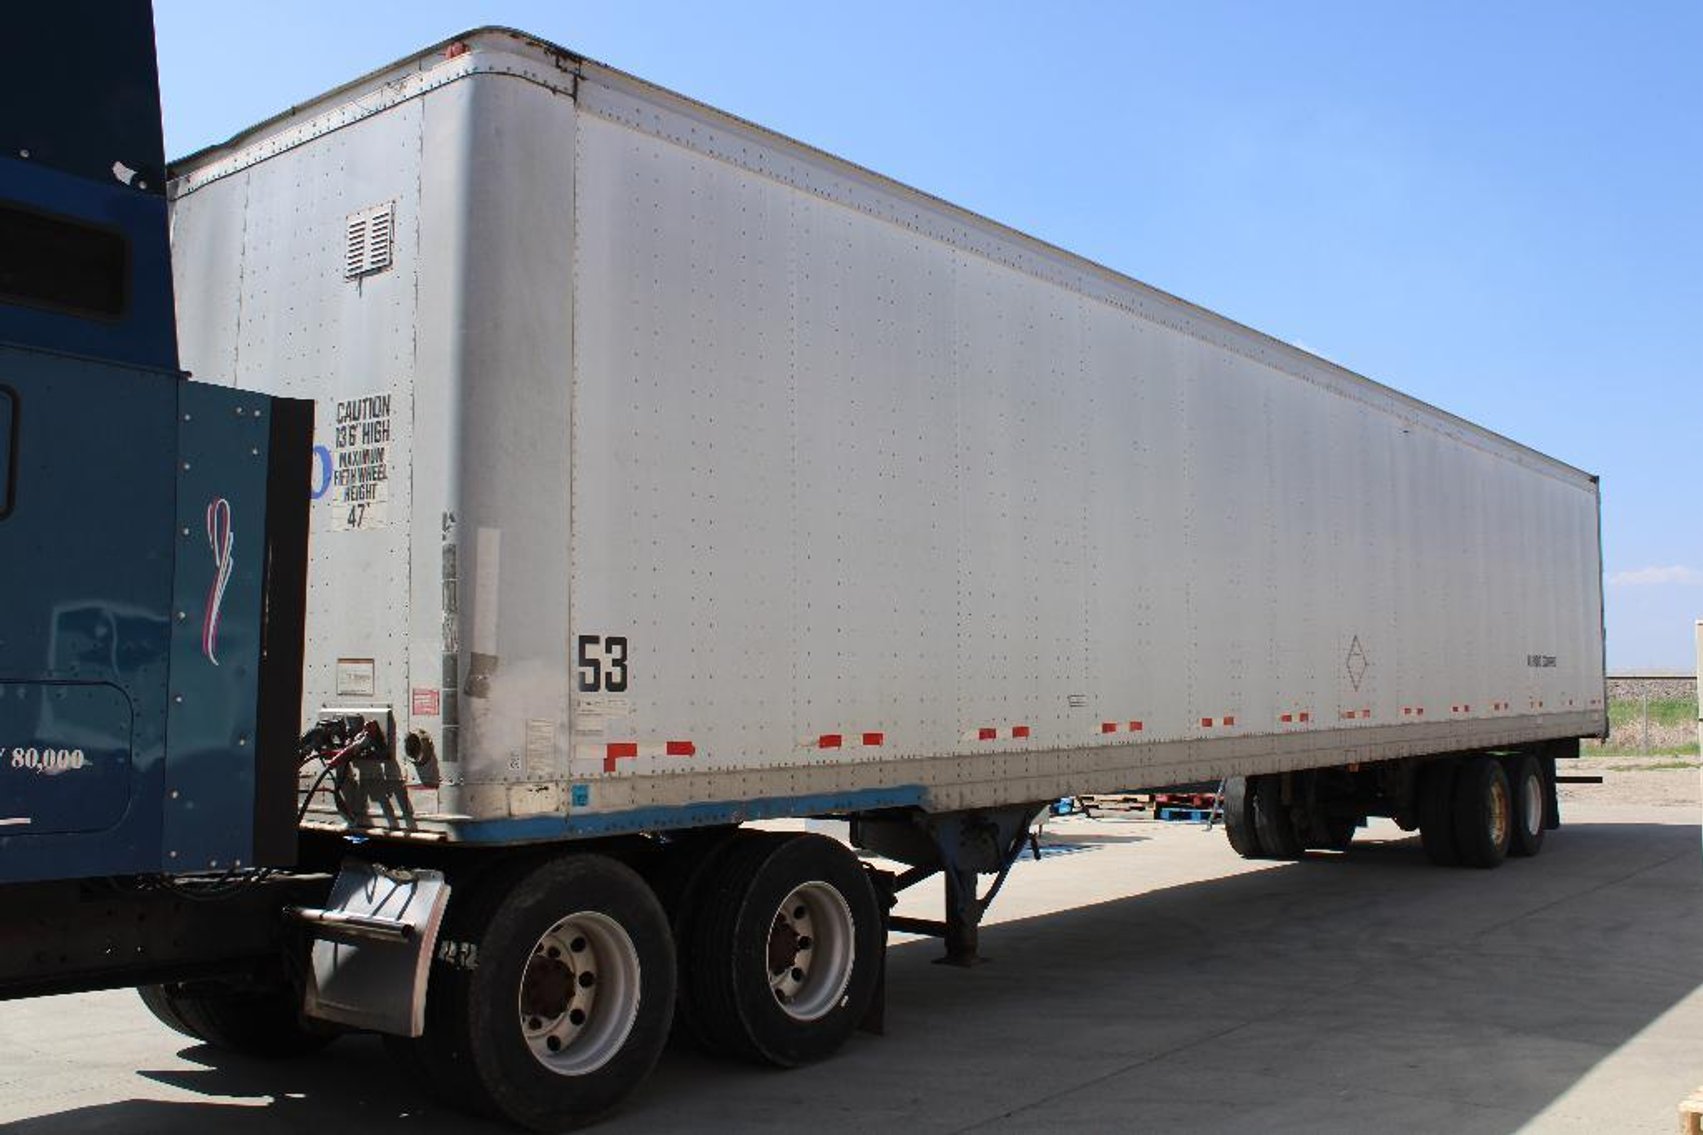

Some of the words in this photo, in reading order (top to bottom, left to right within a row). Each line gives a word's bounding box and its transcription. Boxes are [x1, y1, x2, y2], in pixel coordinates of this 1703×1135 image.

[336, 394, 391, 424] CAUTION
[362, 419, 390, 445] HIGH
[339, 447, 385, 468] MAXIMUM
[344, 483, 377, 501] HEIGHT
[578, 635, 628, 692] 53
[11, 747, 84, 774] 80,000
